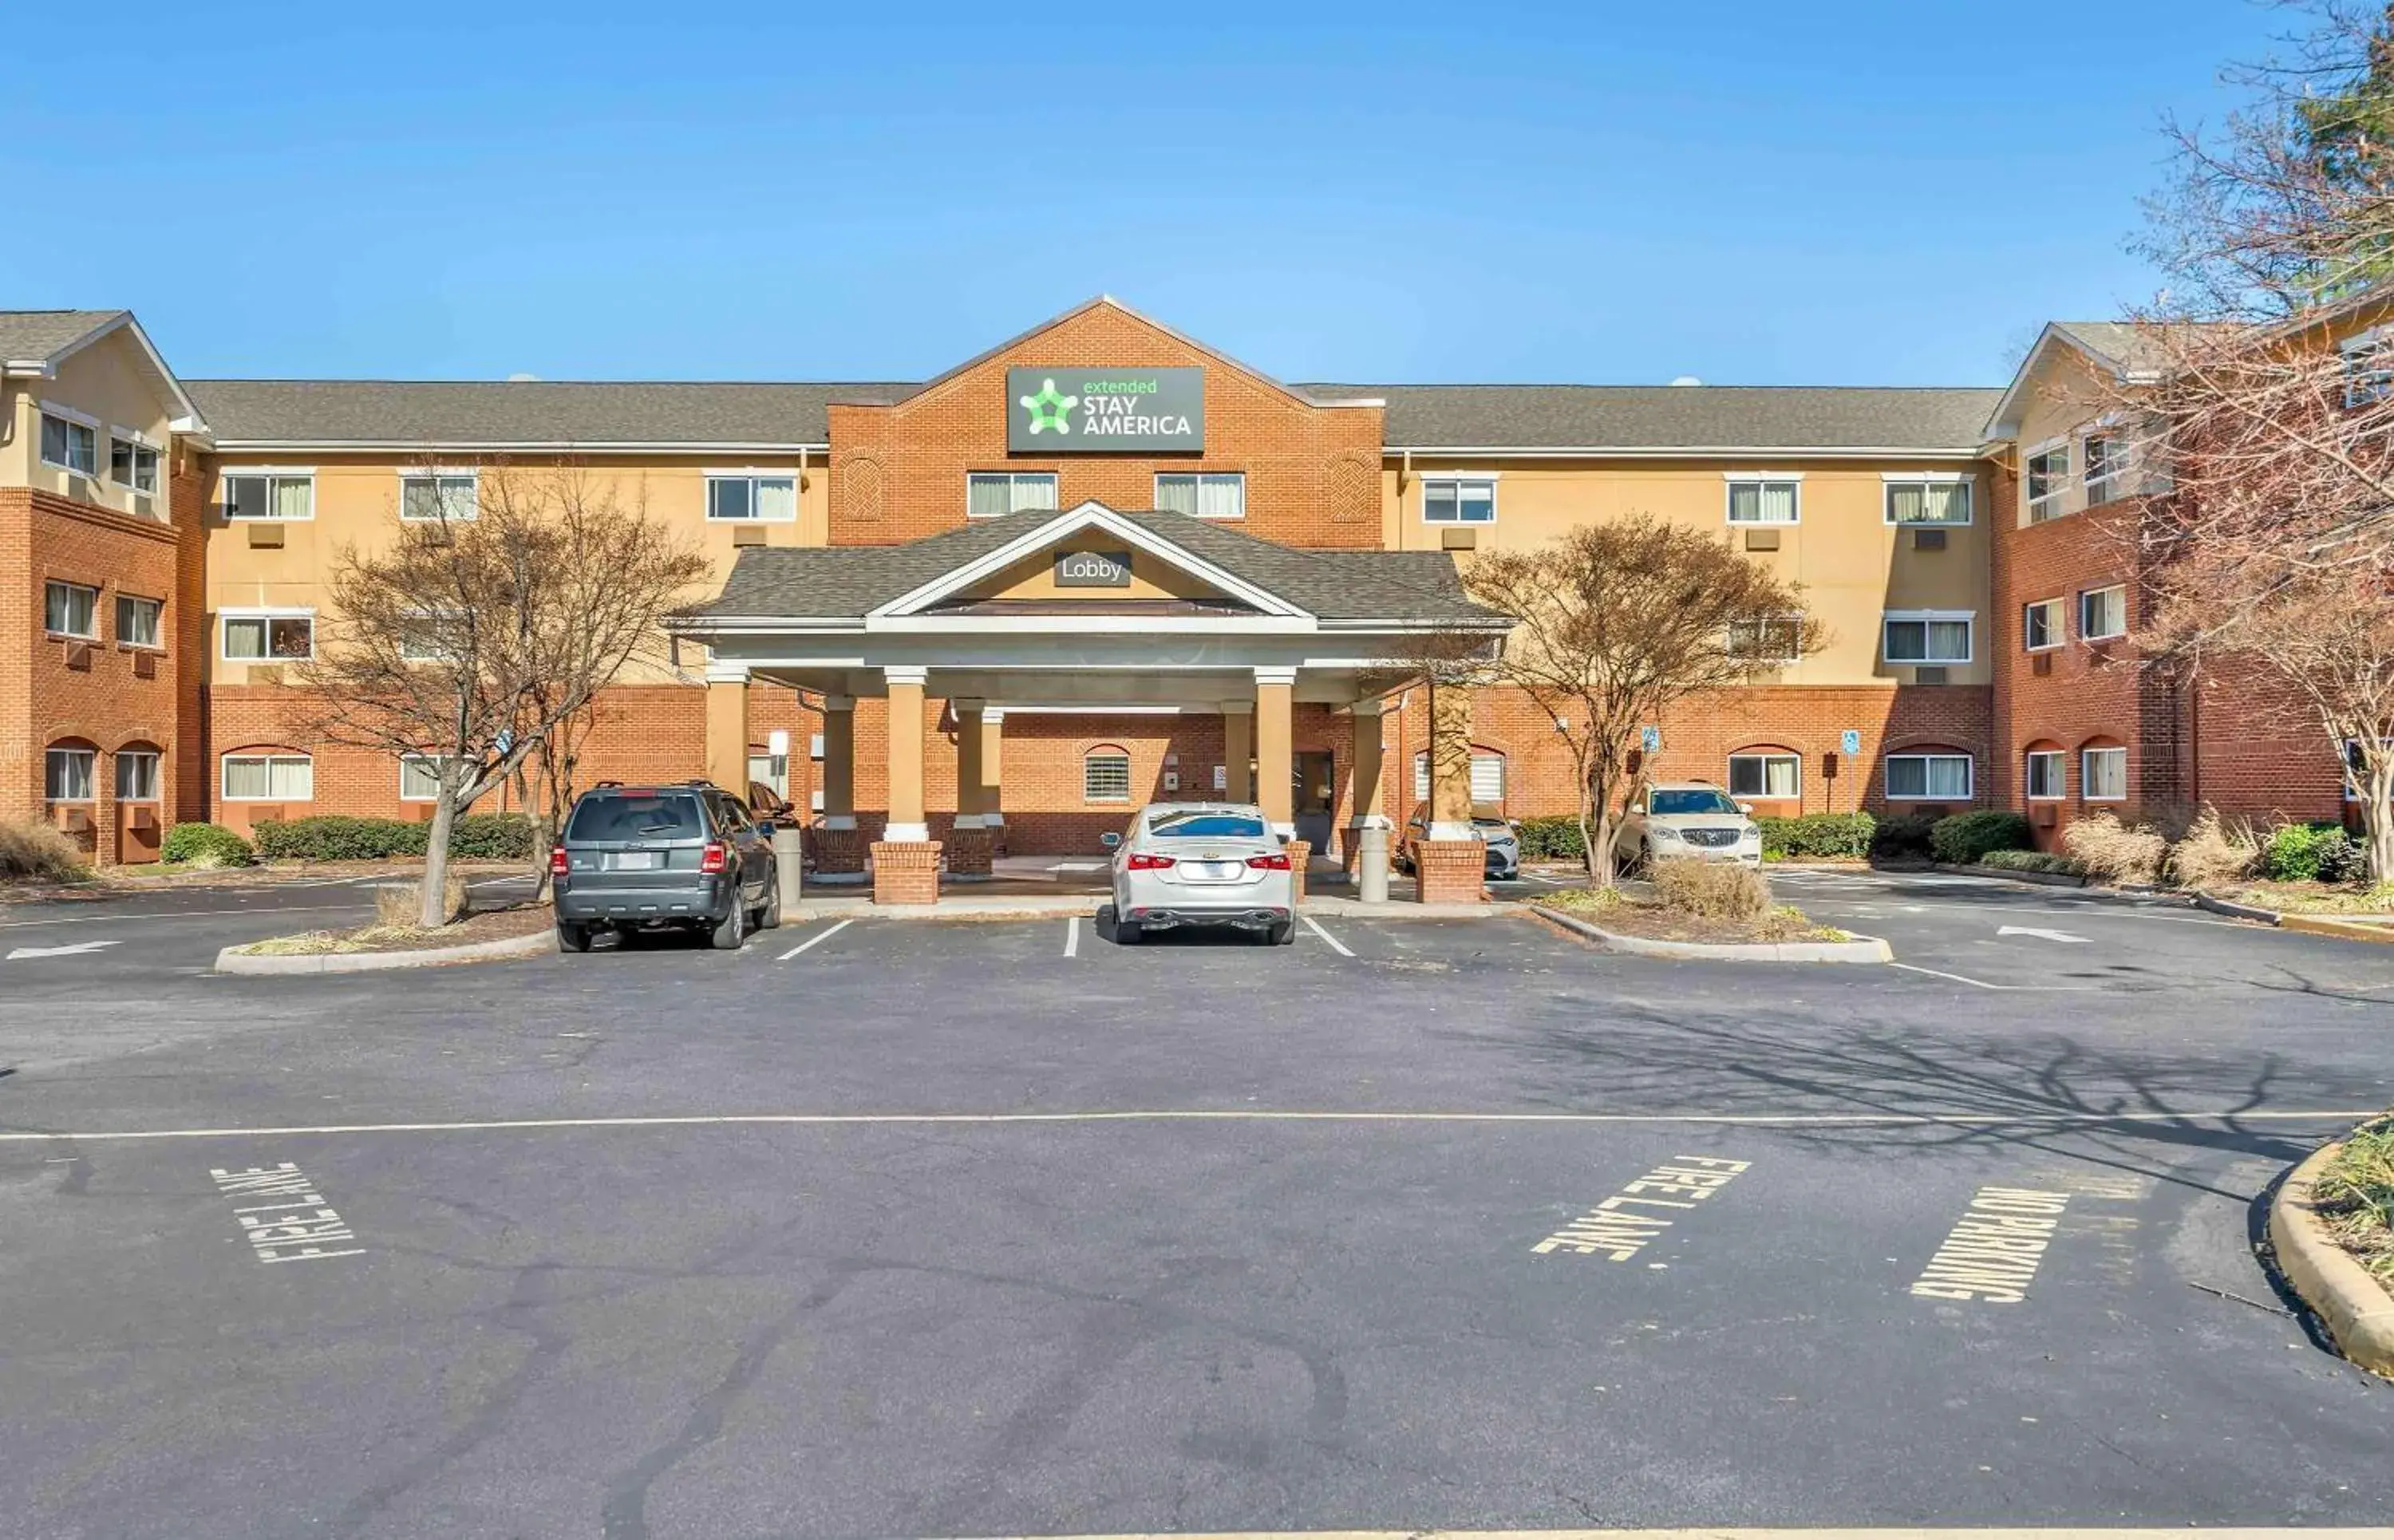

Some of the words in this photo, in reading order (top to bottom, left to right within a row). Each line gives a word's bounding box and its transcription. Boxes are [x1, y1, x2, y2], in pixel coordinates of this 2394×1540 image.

[1083, 379, 1157, 394] extended
[1084, 397, 1138, 415] STAY
[1083, 417, 1191, 435] AMERICA
[1063, 560, 1122, 581] Lobby
[210, 1162, 326, 1213] LANE
[1623, 1155, 1753, 1199] FIRE
[1970, 1187, 2071, 1214] NO
[239, 1209, 367, 1263] FIRE
[1529, 1196, 1697, 1262] LANE
[1910, 1212, 2058, 1302] PARKING
